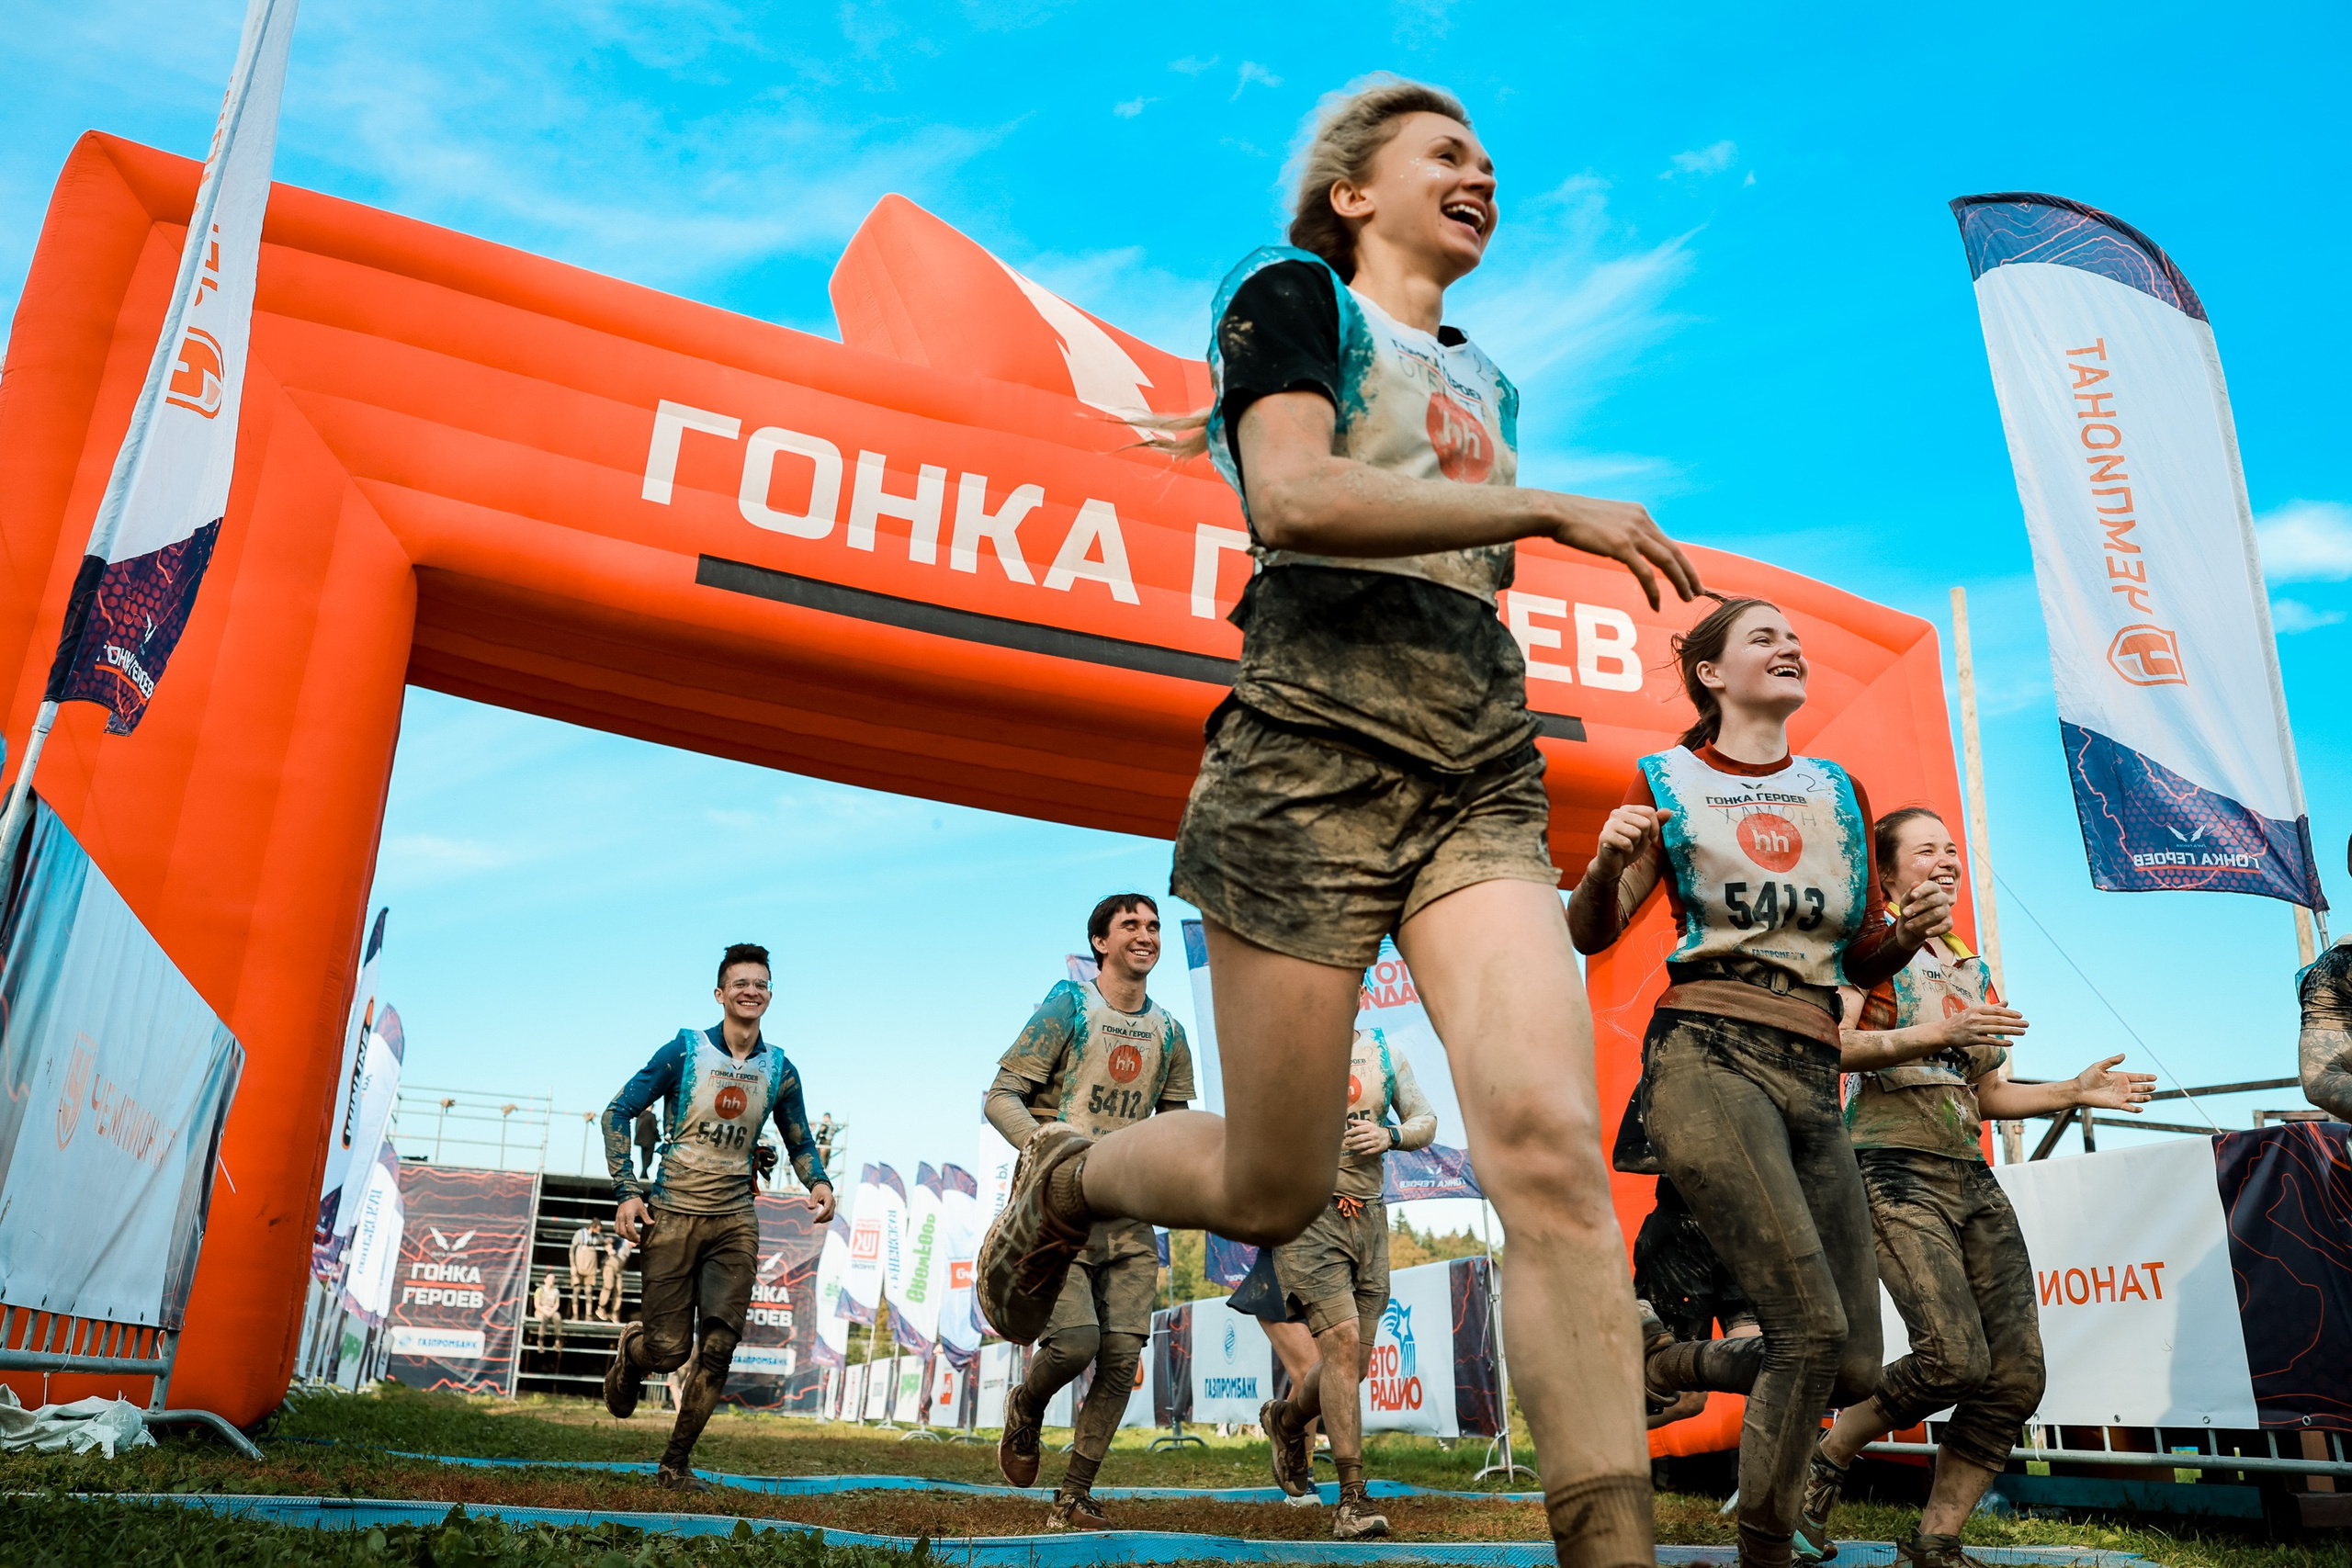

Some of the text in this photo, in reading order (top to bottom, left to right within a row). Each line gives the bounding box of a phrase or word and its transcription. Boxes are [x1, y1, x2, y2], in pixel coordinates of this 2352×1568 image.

[641, 399, 1643, 694] ГОНКА ГЕВ
[1705, 793, 1807, 806] ГОНКА ГЕРОЕВ
[1751, 828, 1791, 853] hh
[1724, 880, 1826, 931] 5413
[1102, 1024, 1152, 1039] ГОНКА ГЕРОЕВ
[710, 1069, 759, 1081] ГОНКА ГЕРОЕВ
[1115, 1055, 1136, 1073] hh
[722, 1096, 741, 1110] hh
[1088, 1084, 1142, 1119] 5412
[695, 1121, 748, 1150] 5416
[411, 1262, 481, 1284] ГОНКА
[402, 1286, 484, 1309] ГЕРОЕВ
[751, 1285, 790, 1303] НКА
[745, 1308, 793, 1327] РОЕВ
[1367, 1344, 1397, 1379] ВТО
[1204, 1377, 1258, 1399] ГАЗПРОМБАНК
[1370, 1376, 1423, 1412] РАДИО
